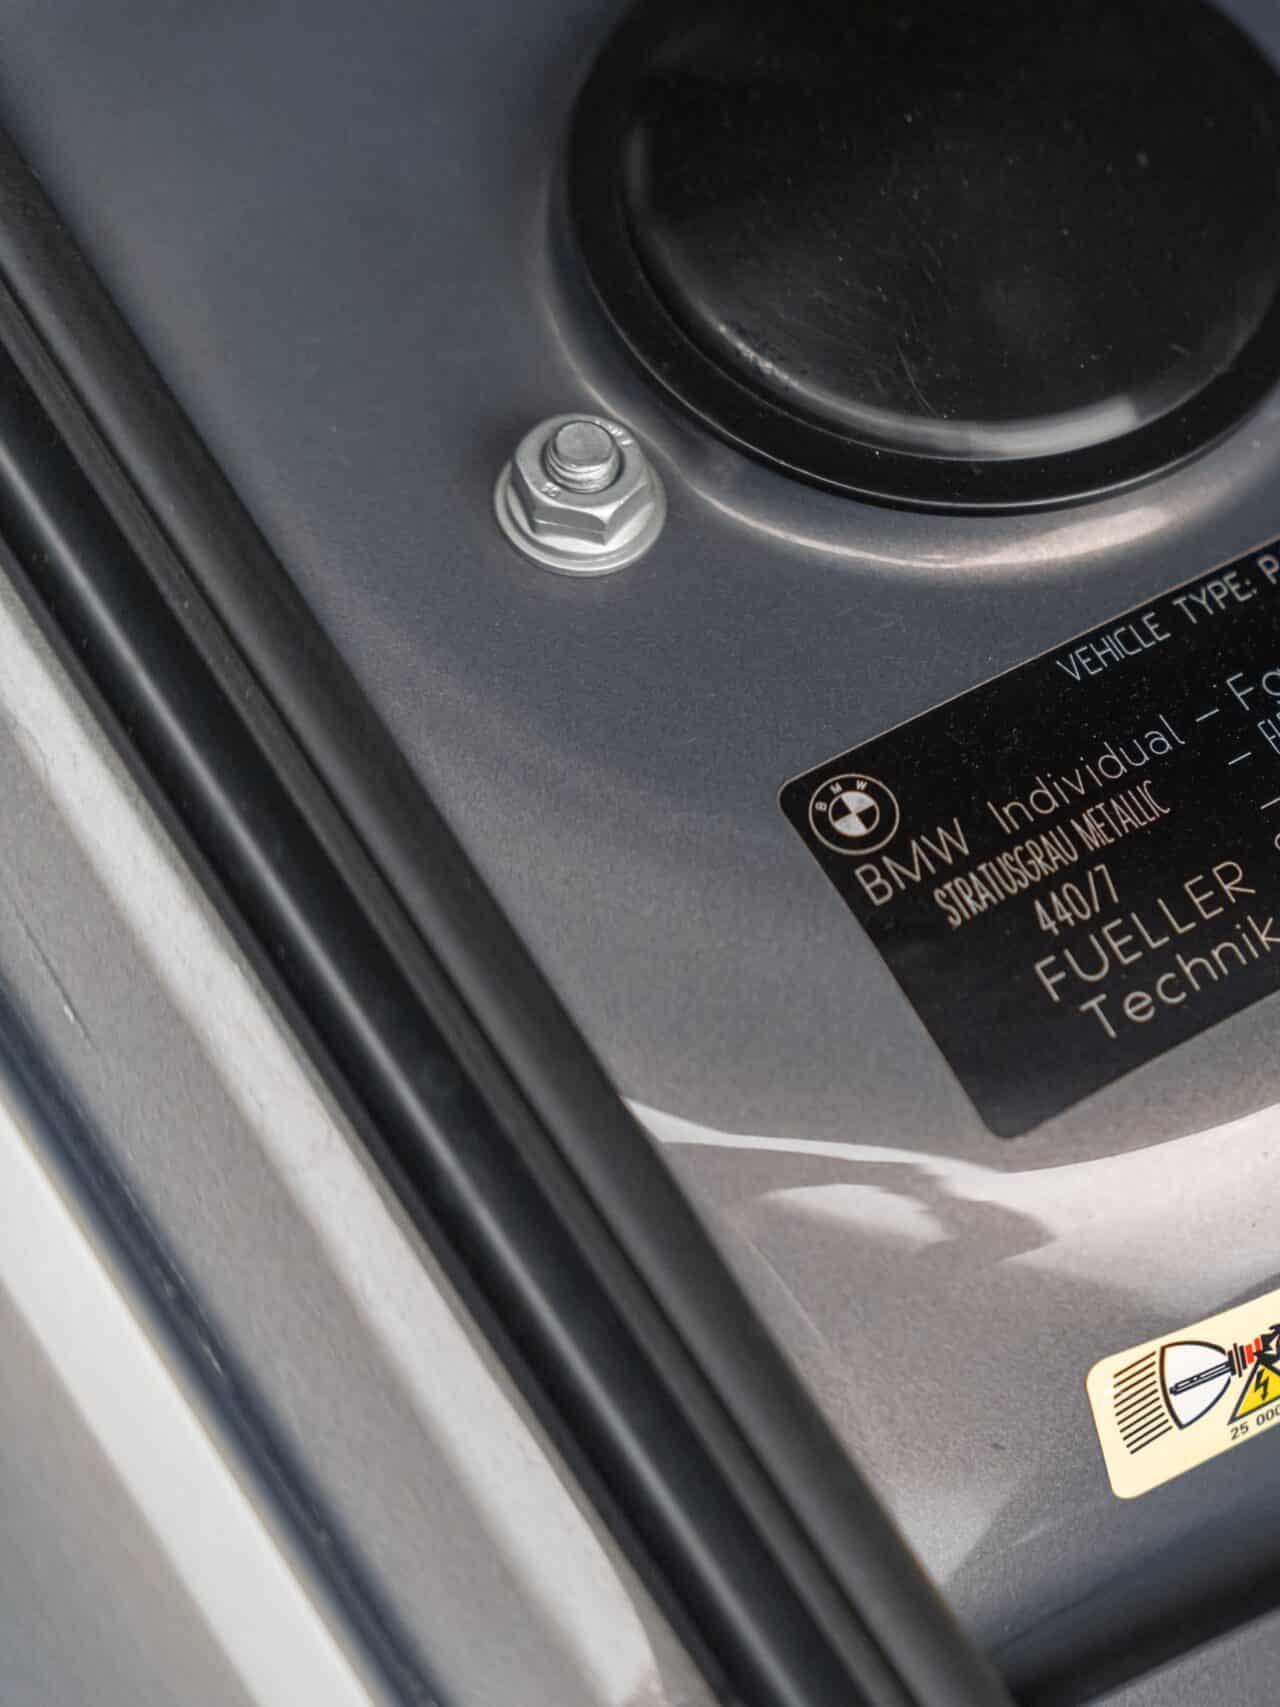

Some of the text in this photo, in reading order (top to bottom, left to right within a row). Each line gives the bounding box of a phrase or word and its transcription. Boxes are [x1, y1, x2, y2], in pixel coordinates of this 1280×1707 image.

[1056, 612, 1171, 681] VEHICLE
[1173, 571, 1257, 624] TYPE:
[854, 817, 969, 906] BMW
[987, 714, 1186, 834] Individual
[933, 825, 1079, 929] STRATUSGRAU
[1070, 780, 1170, 851] METALLIC
[1034, 864, 1119, 936] 440/7
[1034, 861, 1256, 1003] FUELLER
[1230, 1423, 1249, 1440] 25
